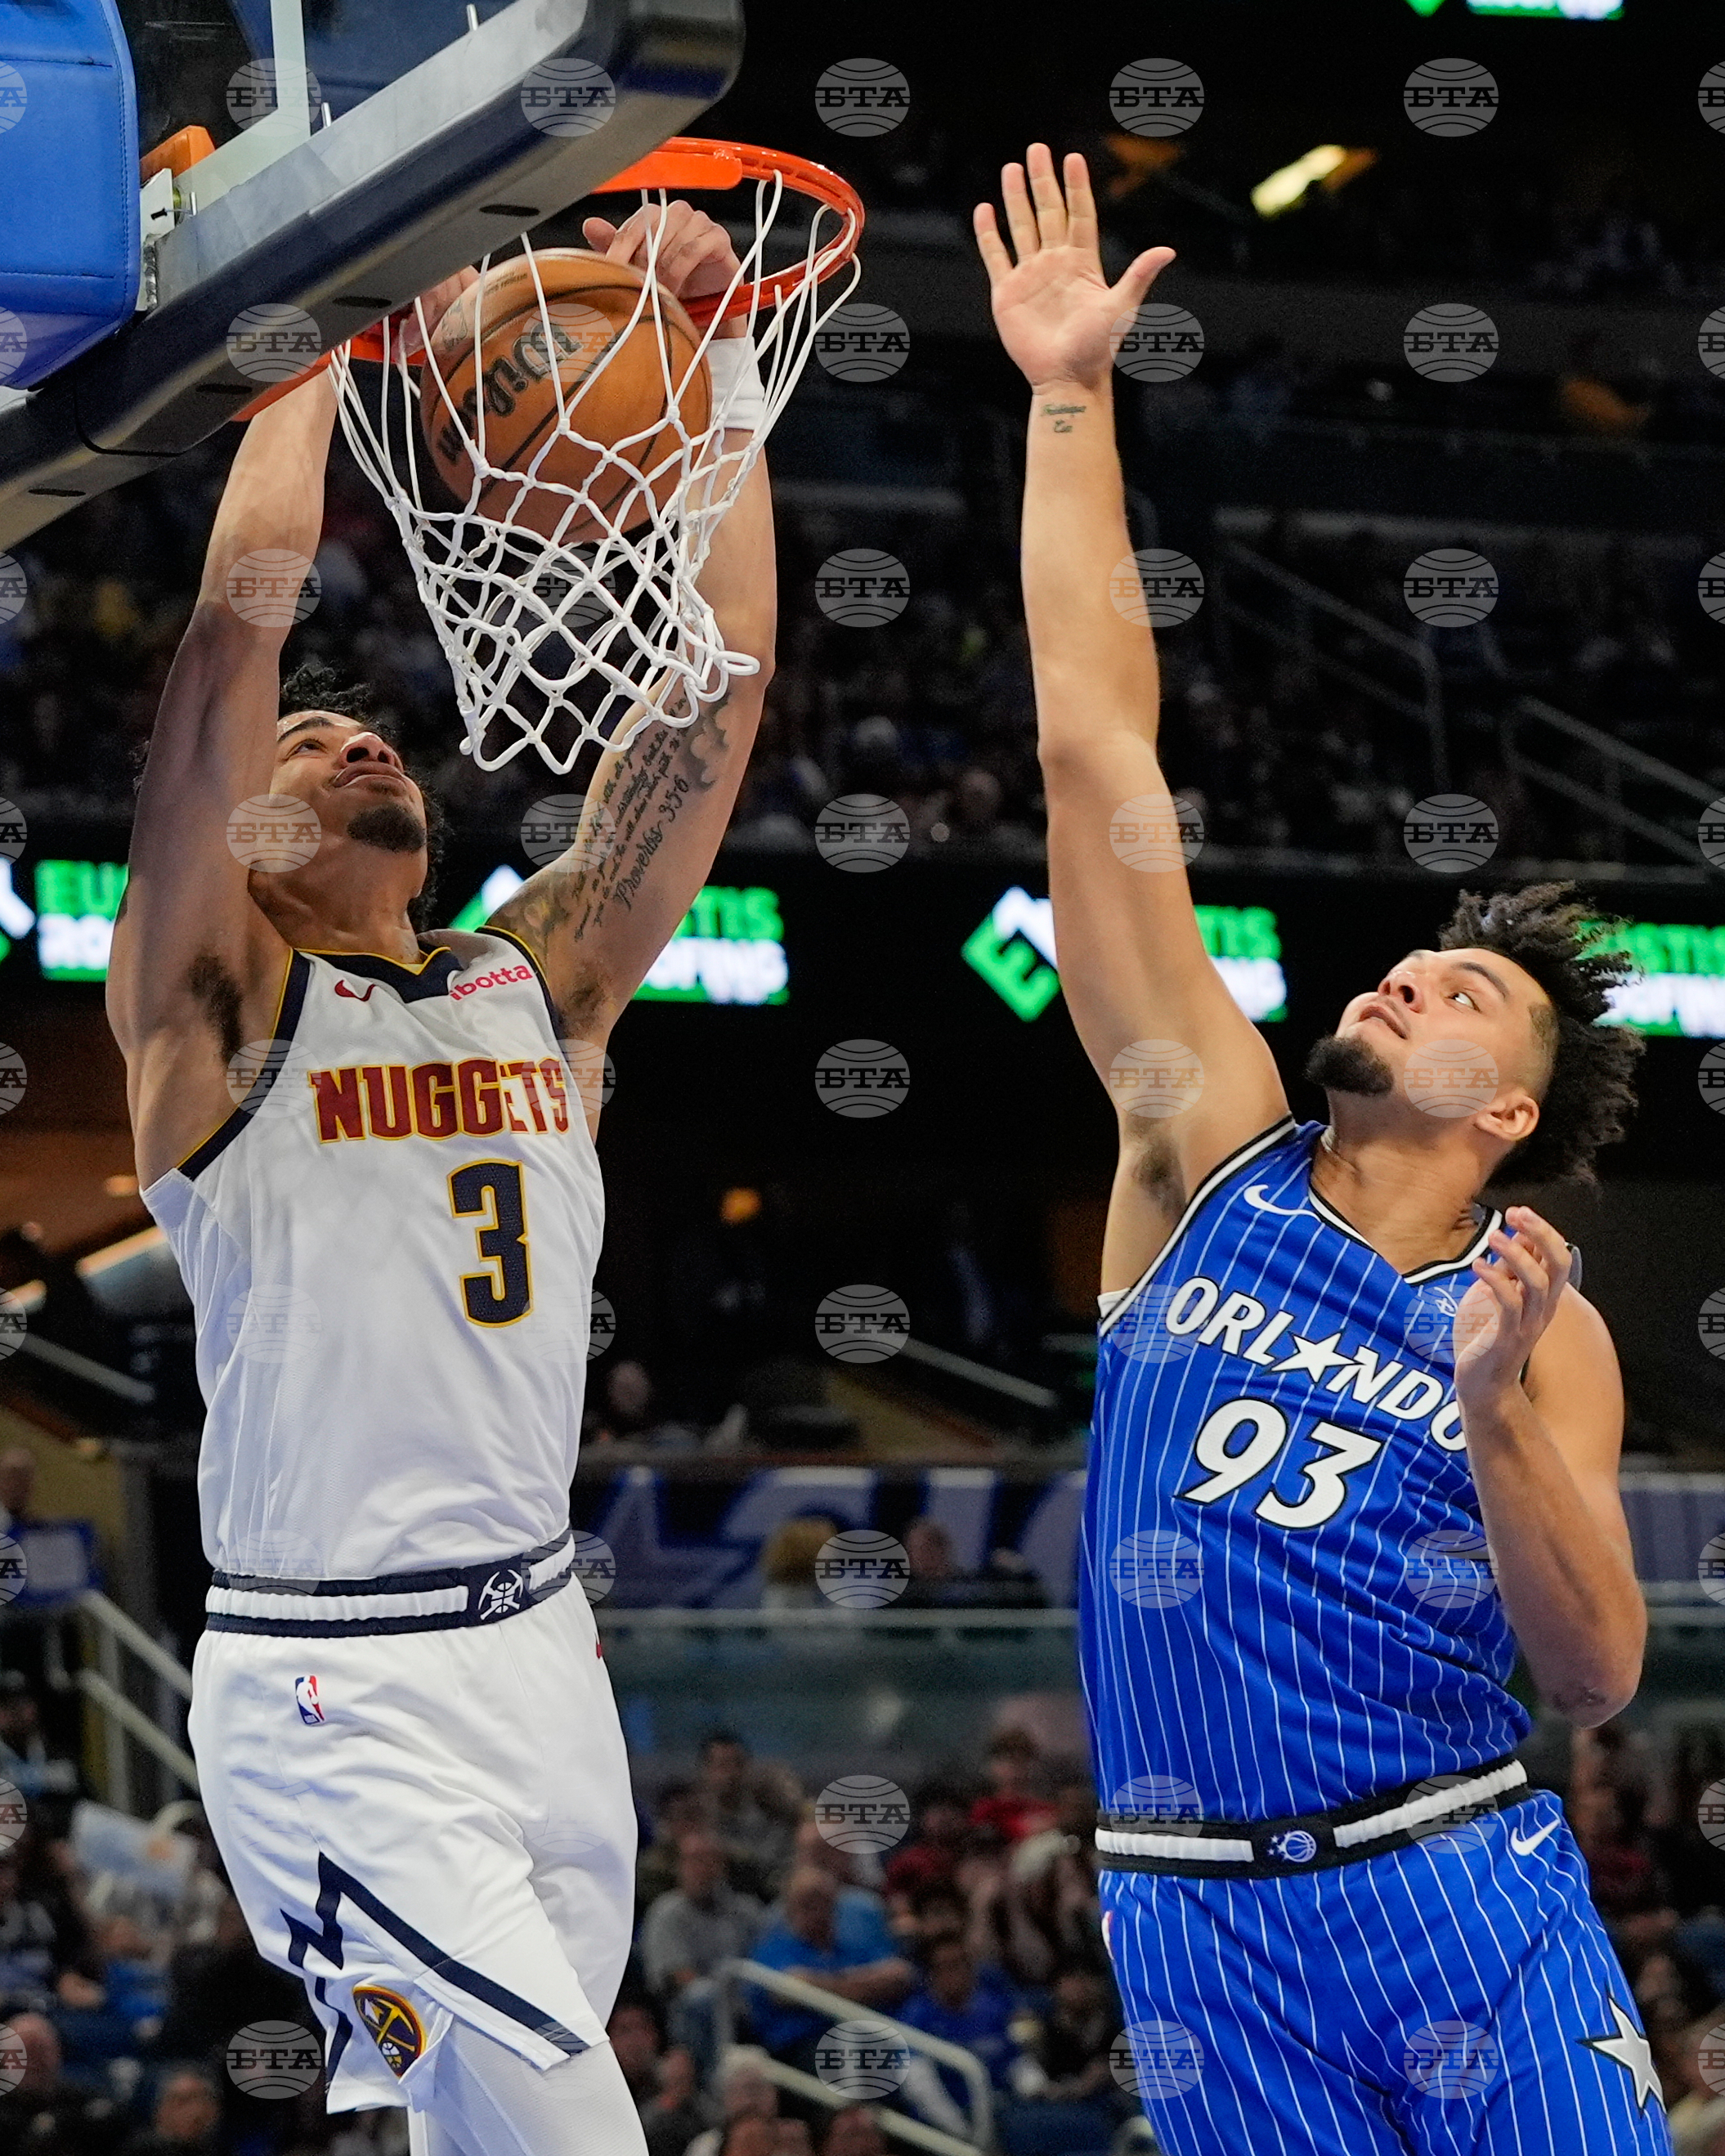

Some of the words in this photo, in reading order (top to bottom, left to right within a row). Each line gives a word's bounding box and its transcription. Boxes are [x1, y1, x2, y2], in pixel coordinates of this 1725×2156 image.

[612, 820, 663, 910] Proverbs
[450, 965, 533, 1001] ibotta
[308, 1057, 570, 1144] NUGGETS
[449, 1159, 534, 1328] 3
[1174, 1397, 1383, 1529] 93
